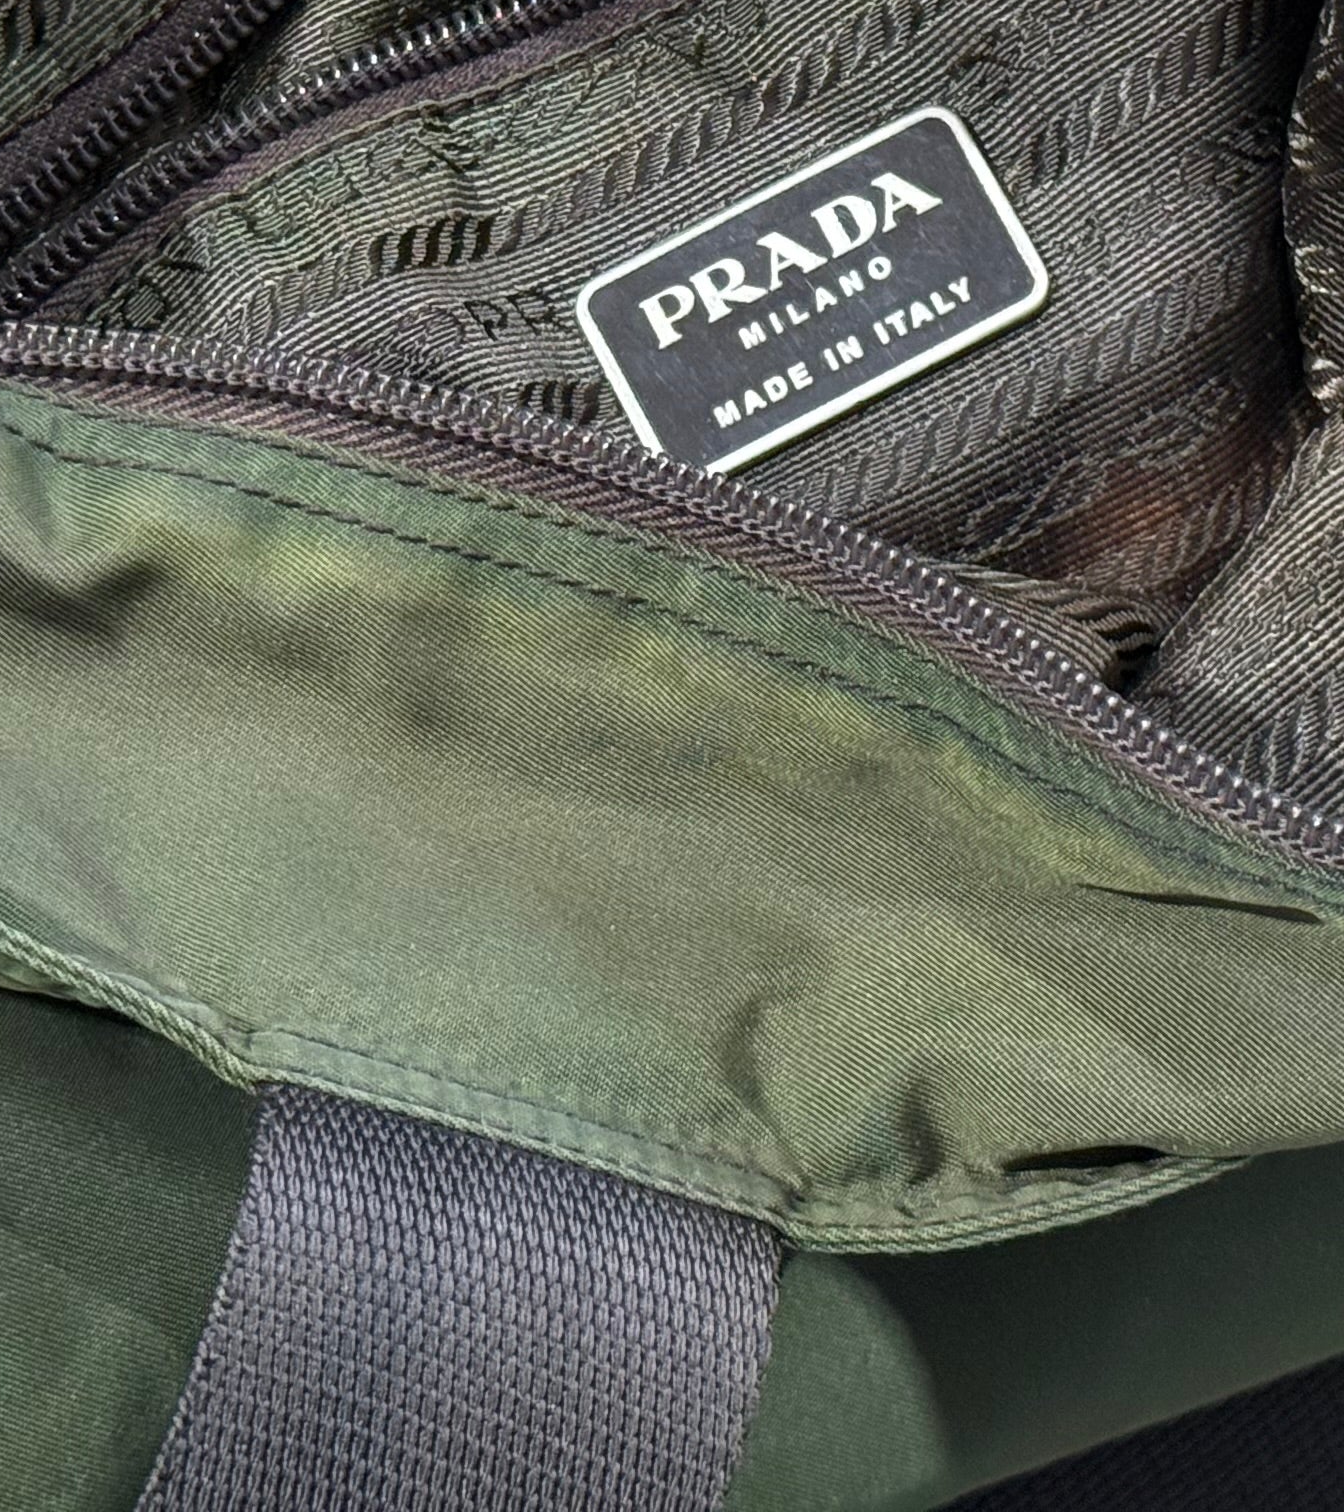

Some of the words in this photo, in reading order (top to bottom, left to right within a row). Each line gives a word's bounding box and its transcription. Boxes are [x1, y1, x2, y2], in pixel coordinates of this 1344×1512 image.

[638, 172, 943, 350] PRADA
[738, 256, 892, 350] MILANO
[713, 361, 814, 429] MADE
[822, 335, 864, 371] IN
[872, 276, 971, 345] ITALY
